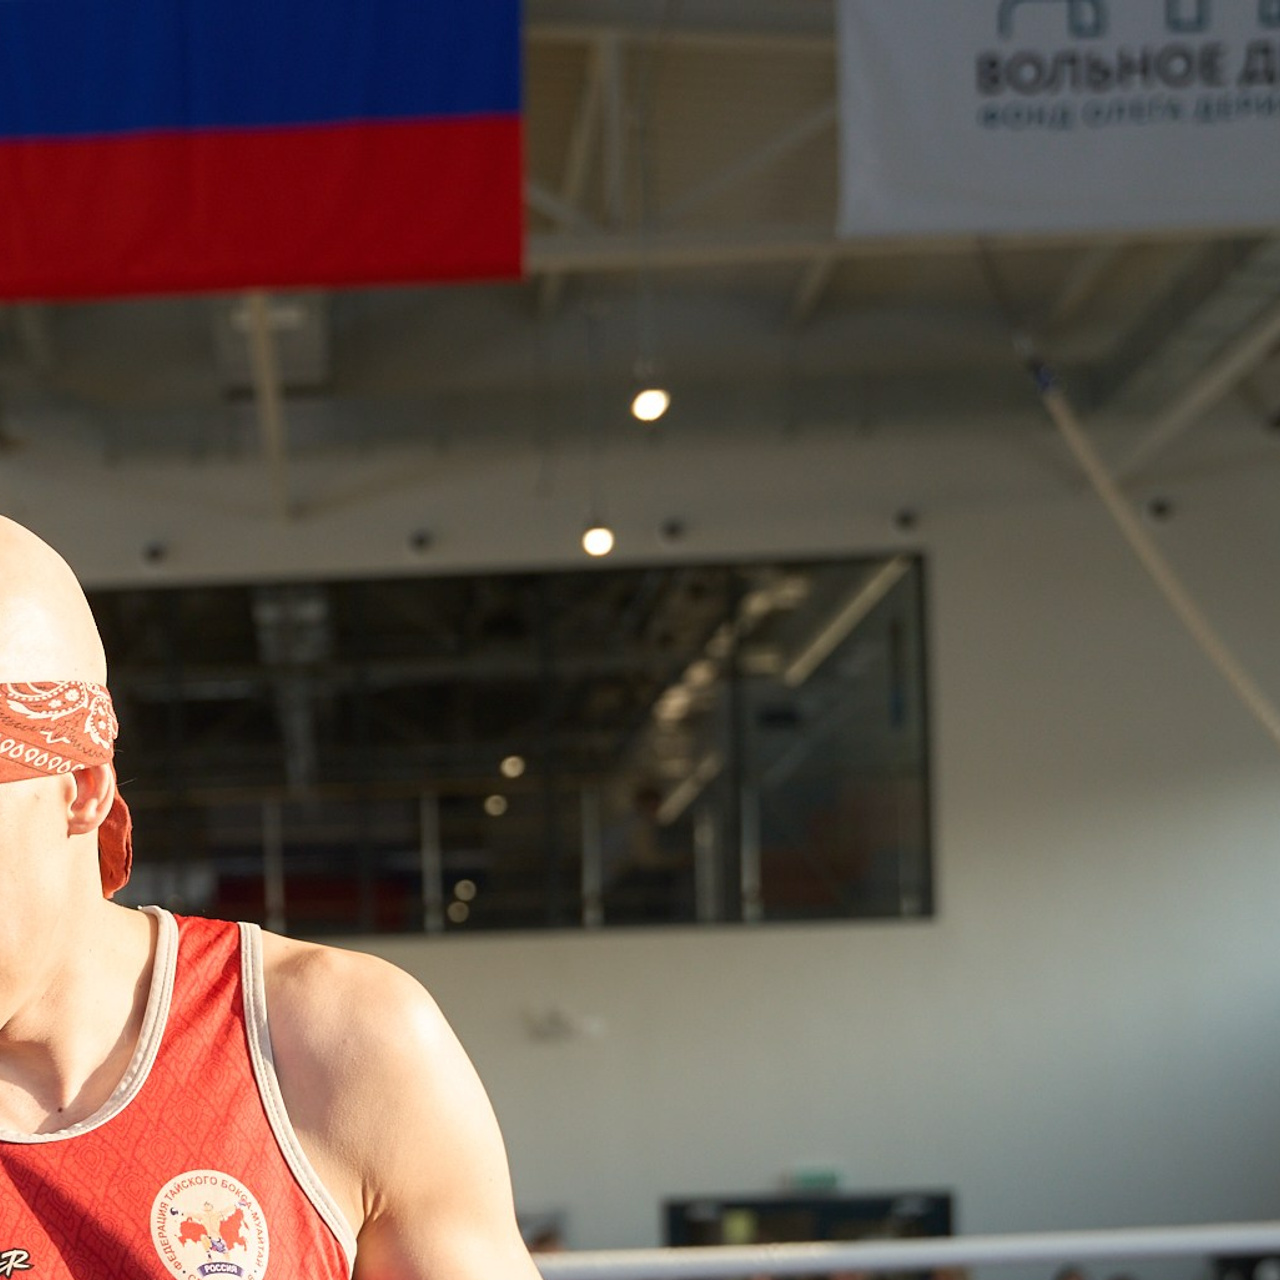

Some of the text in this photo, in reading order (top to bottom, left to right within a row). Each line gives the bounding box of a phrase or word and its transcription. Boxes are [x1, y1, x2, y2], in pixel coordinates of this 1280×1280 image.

[976, 43, 1228, 95] ВОЛЬНОЕ
[164, 1175, 218, 1202] ТАЙСКОГО
[157, 1201, 183, 1271] ФЕДЕРАЦИЯ
[204, 1263, 238, 1274] РОССИЯ
